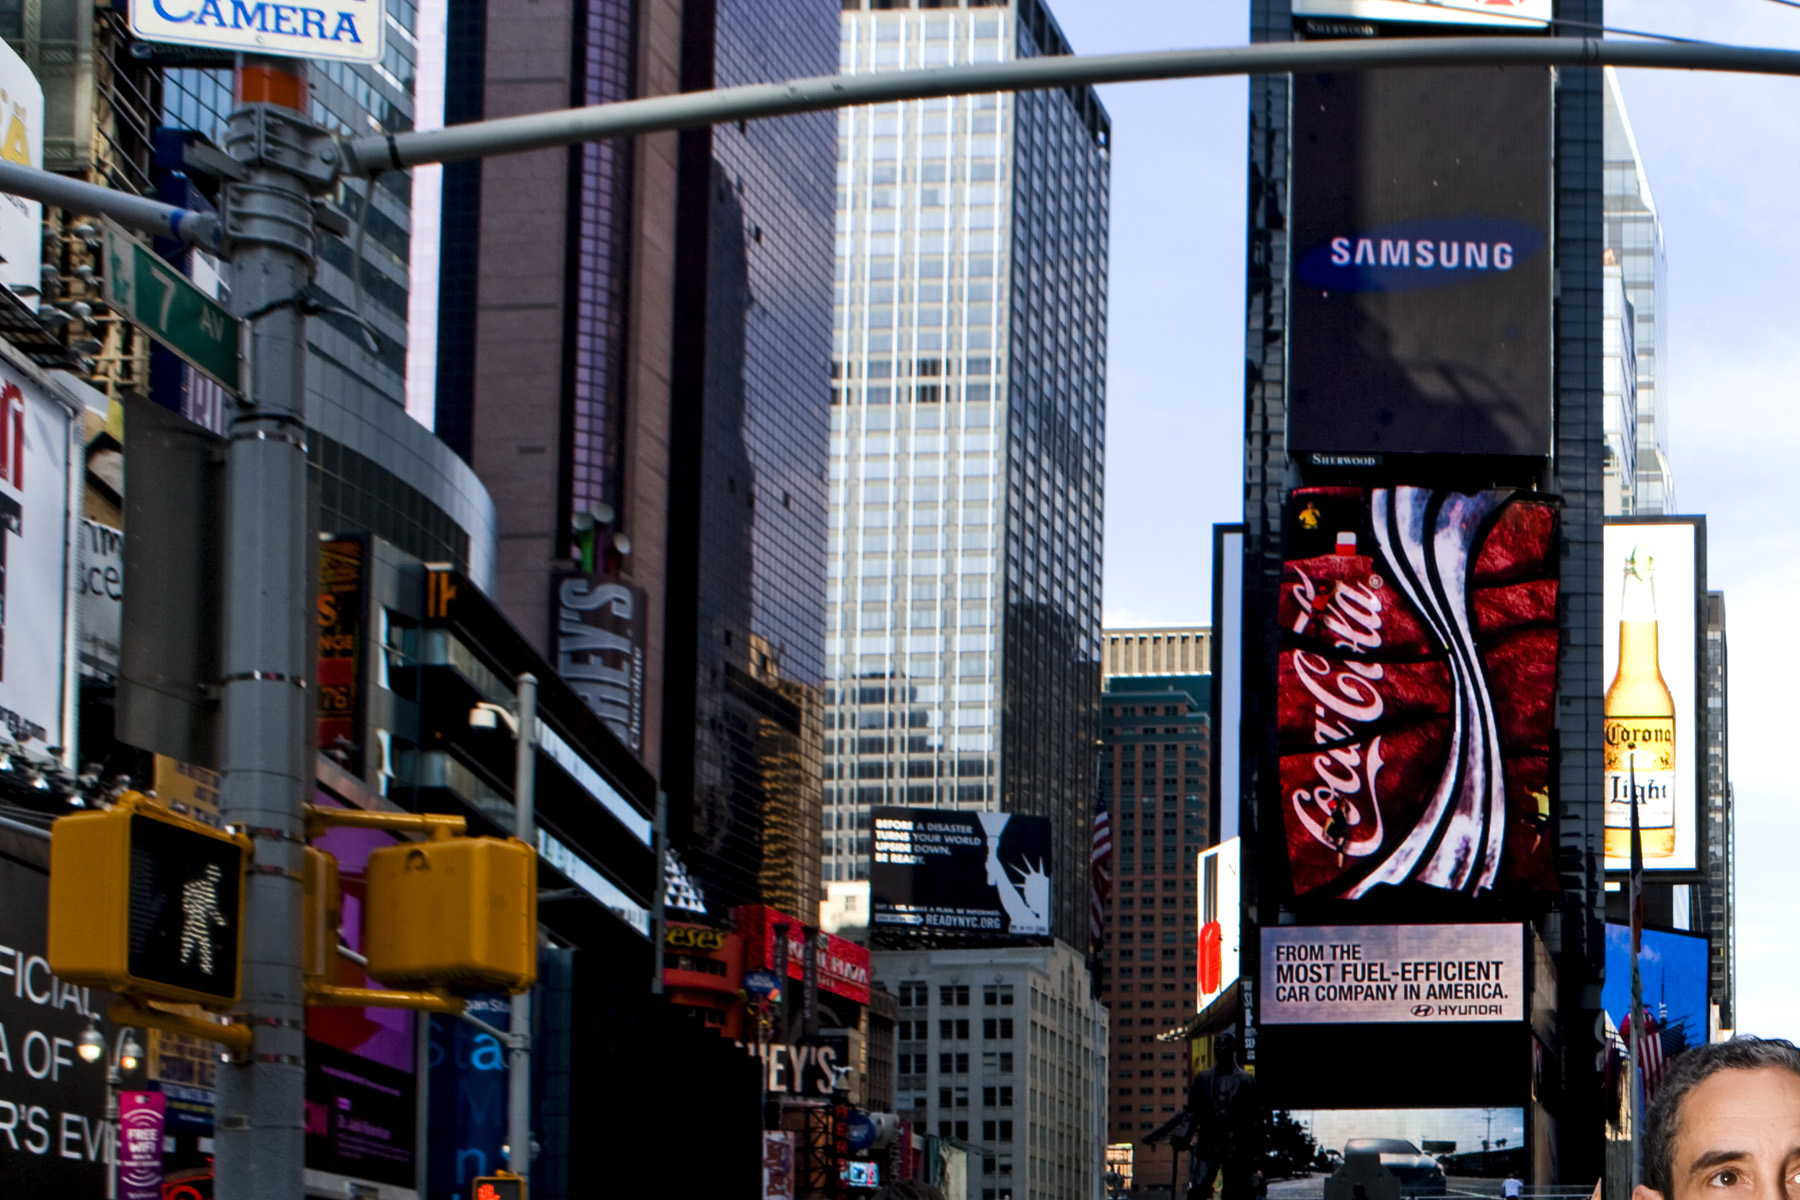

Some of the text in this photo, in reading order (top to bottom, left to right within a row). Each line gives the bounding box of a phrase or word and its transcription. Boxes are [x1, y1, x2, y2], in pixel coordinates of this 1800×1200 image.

[1306, 20, 1375, 37] SHERWOOD
[1330, 236, 1514, 270] SAMSUNG
[150, 267, 226, 345] 7 AV
[1311, 452, 1376, 467] SHERWOOD
[1291, 564, 1385, 858] Coca-Cola
[1605, 722, 1673, 747] Corona
[874, 818, 974, 834] BEFORE A DISASTER
[874, 830, 982, 846] TURNS YOUR WORLD
[874, 841, 912, 853] UPSIDE
[874, 852, 889, 864] BE
[925, 914, 1001, 929] READYNYC.ORG
[1275, 943, 1362, 962] FROM THE
[1275, 960, 1505, 984] MOST FUEL-EFFICIENT
[1275, 982, 1509, 1003] CAR COMPANY IN AMERICA.
[1437, 1004, 1503, 1016] HYUNDAI
[22, 1029, 75, 1083] OF
[747, 1042, 839, 1094] EY'S
[59, 1111, 119, 1167] EV
